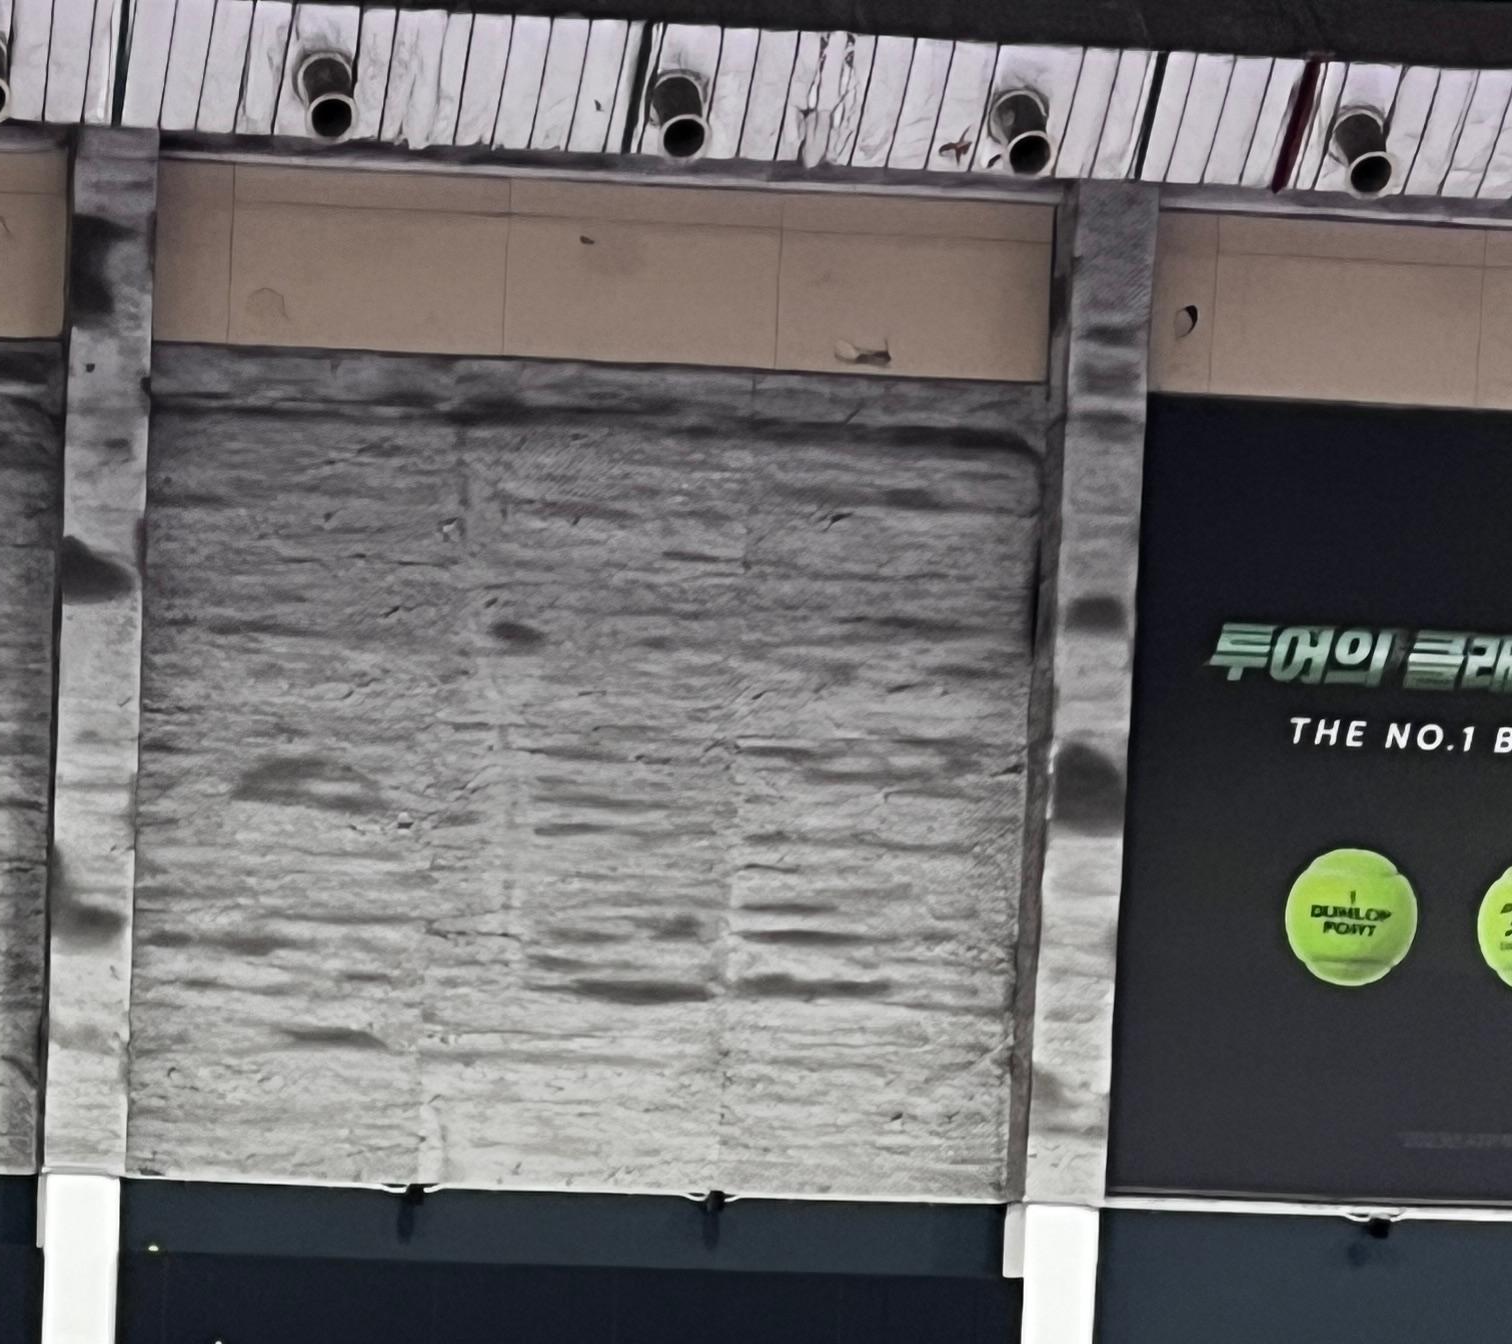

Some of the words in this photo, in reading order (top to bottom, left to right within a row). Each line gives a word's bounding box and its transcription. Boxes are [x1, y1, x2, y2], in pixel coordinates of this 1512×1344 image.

[1206, 622, 1392, 687] 투어의
[1290, 717, 1367, 747] THE
[1385, 722, 1475, 752] NO.1
[1493, 727, 1512, 753] B
